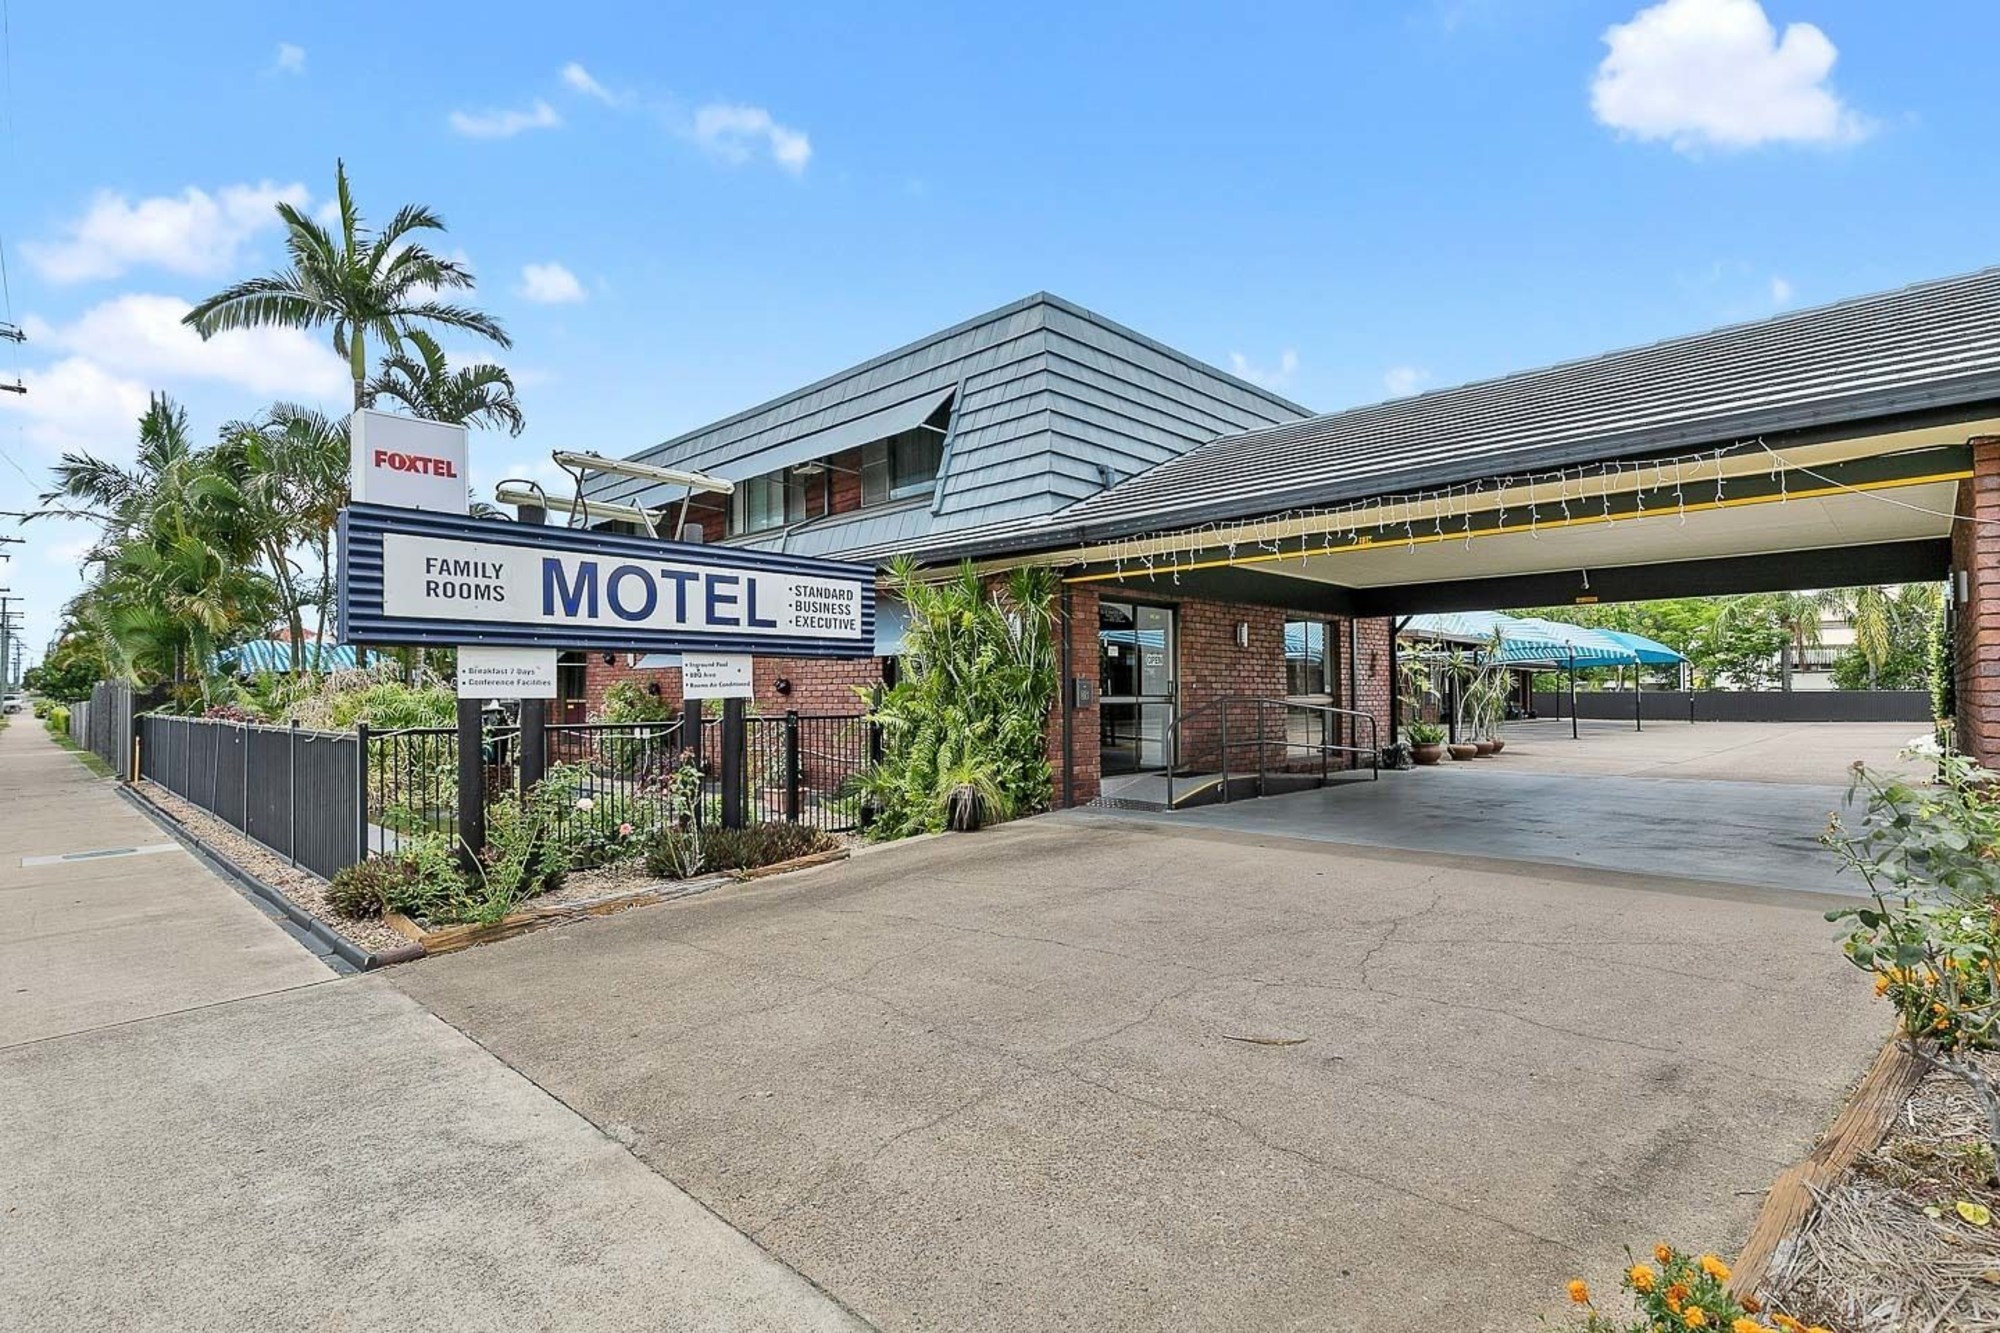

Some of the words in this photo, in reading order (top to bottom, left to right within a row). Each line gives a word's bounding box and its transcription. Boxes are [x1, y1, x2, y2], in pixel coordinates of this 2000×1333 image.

[373, 449, 459, 479] FOXTEL
[425, 556, 504, 580] FAMILY
[425, 579, 505, 602] ROOMS
[541, 556, 777, 629] MOTEL
[794, 585, 854, 602] STANDARD
[794, 600, 852, 617] BUSINESS
[794, 615, 857, 631] EXECUTIVE
[468, 667, 508, 675] Breakfast
[468, 678, 515, 686] Conference
